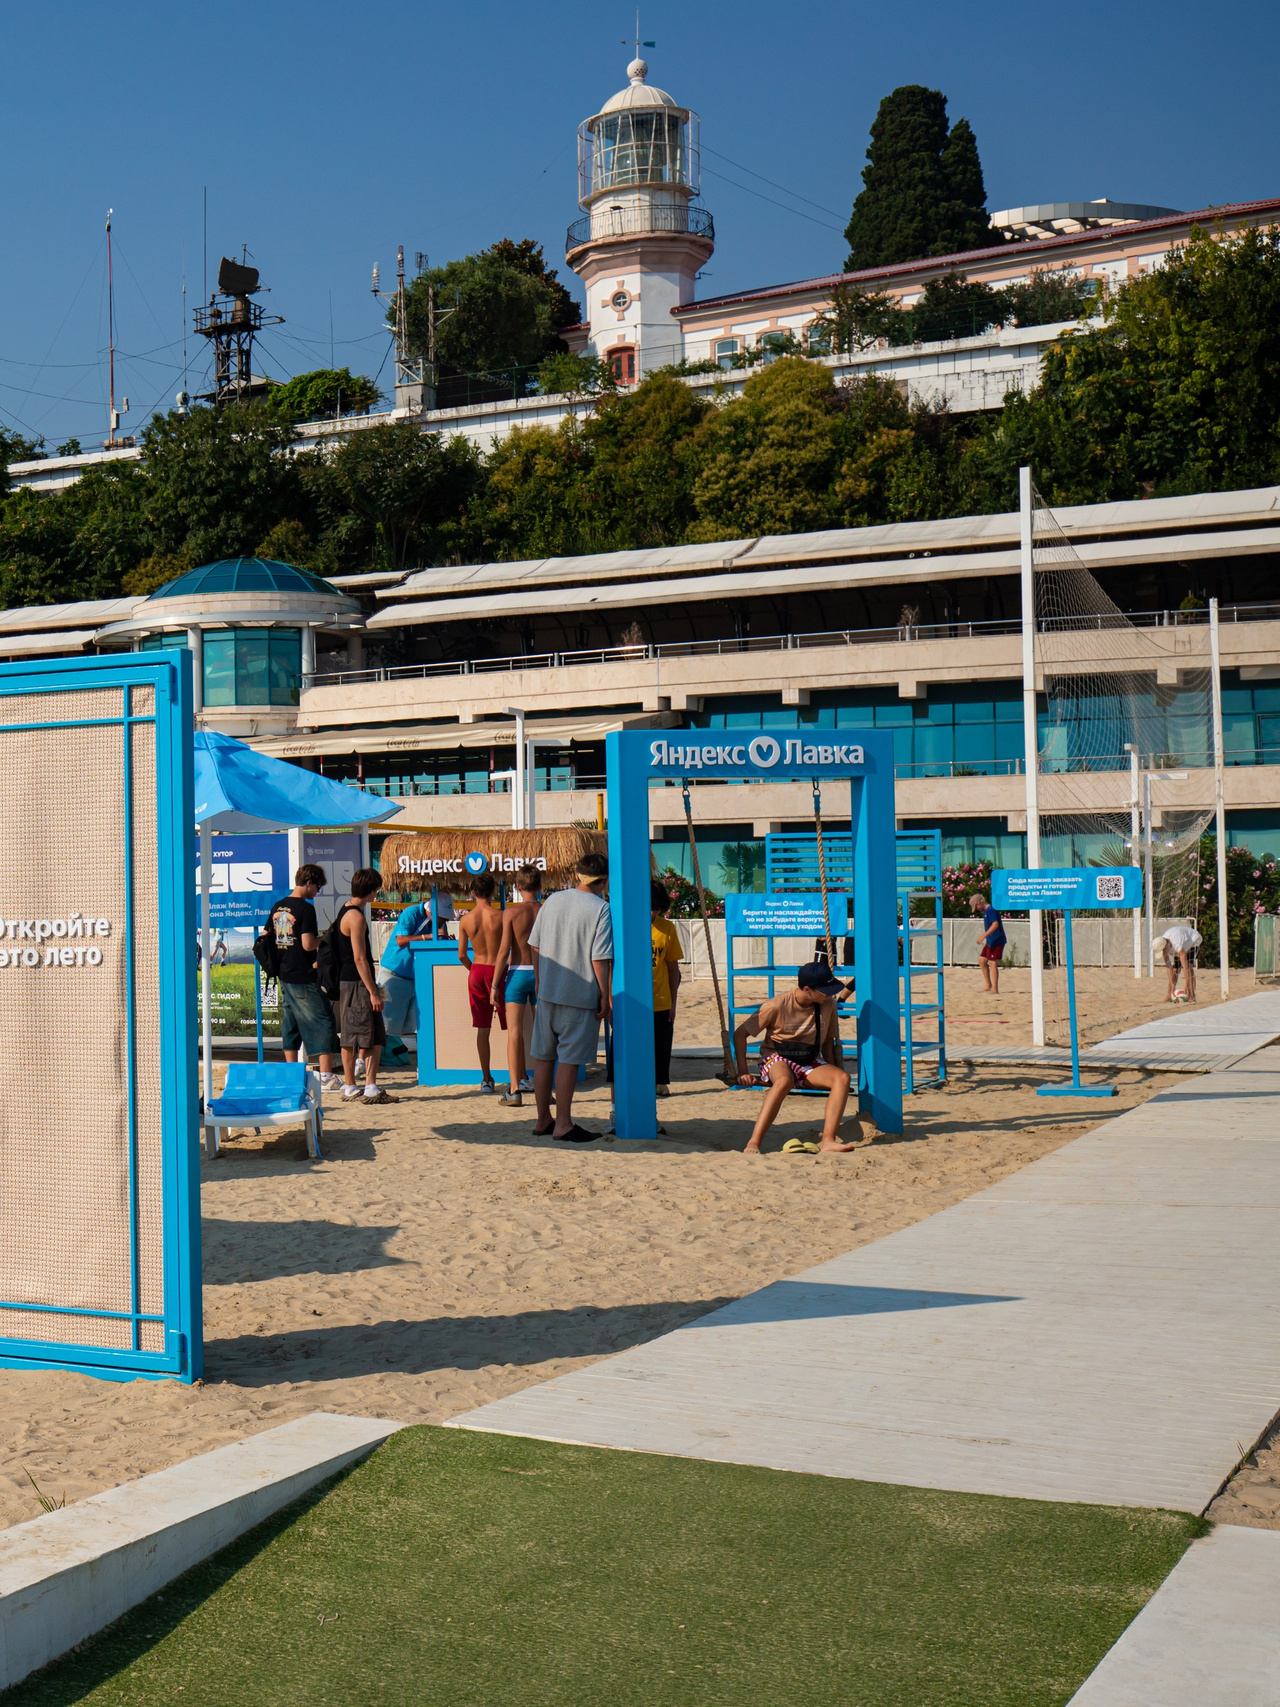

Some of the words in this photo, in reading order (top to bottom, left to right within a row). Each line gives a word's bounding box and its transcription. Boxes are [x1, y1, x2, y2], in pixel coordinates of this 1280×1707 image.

[650, 740, 746, 769] Яндекс
[784, 739, 864, 765] Лавка
[398, 856, 462, 876] Яндекс
[226, 910, 252, 918] Яндекс
[44, 946, 102, 966] лето
